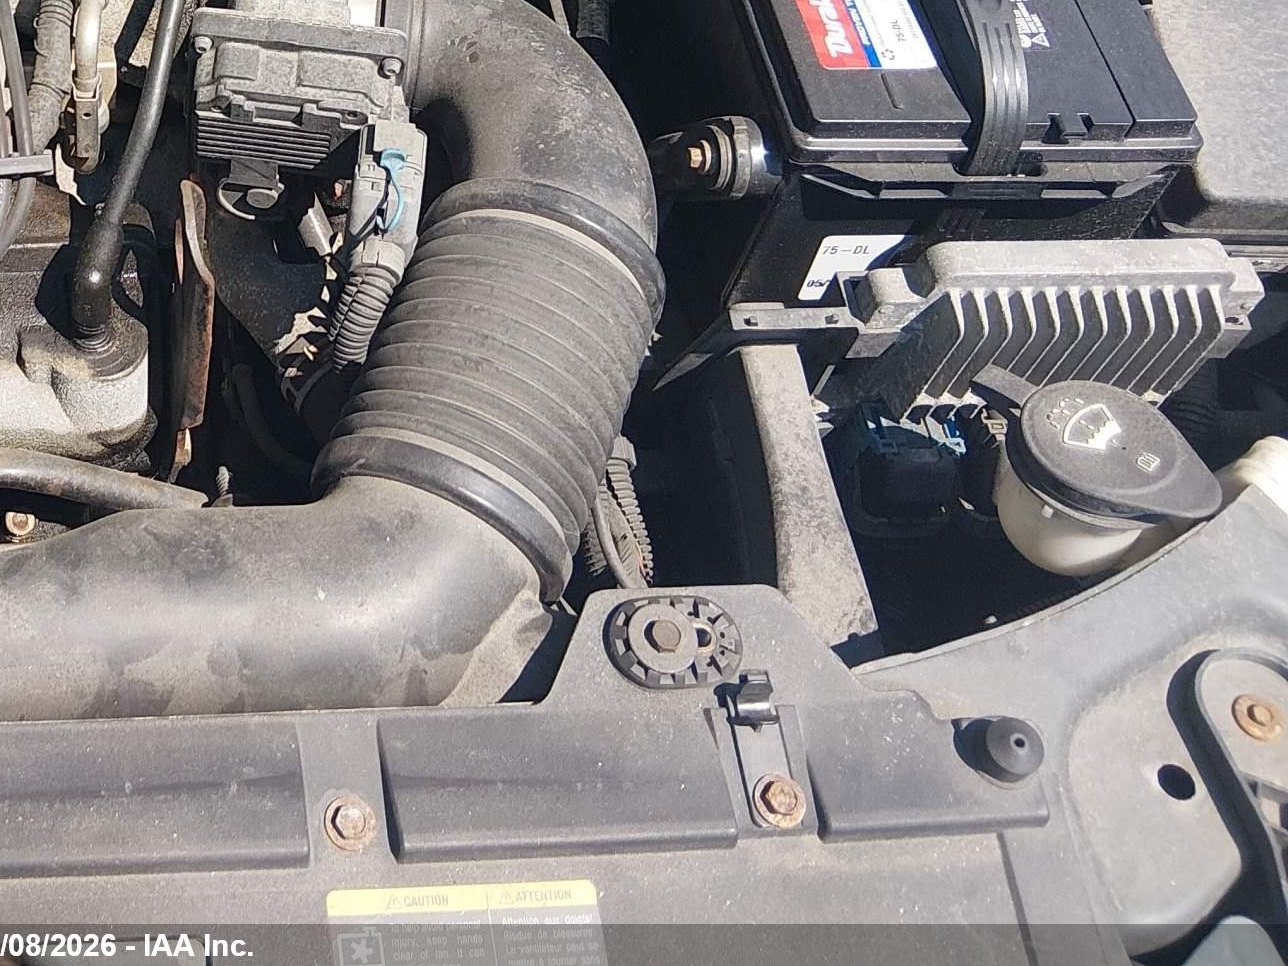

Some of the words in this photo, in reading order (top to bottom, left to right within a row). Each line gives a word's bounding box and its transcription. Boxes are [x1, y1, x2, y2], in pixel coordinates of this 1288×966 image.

[891, 19, 906, 43] 75-DL
[404, 894, 449, 907] CAUTION
[516, 889, 572, 904] ATTENTION
[426, 935, 448, 946] keep
[456, 933, 483, 945] hands
[504, 930, 531, 942] Risque
[537, 929, 549, 940] de
[393, 949, 414, 960] clear
[420, 948, 430, 960] of
[469, 948, 486, 958] can
[506, 945, 517, 956] Le
[519, 942, 564, 955] ventilateur
[566, 942, 585, 954] peut
[588, 942, 600, 952] se
